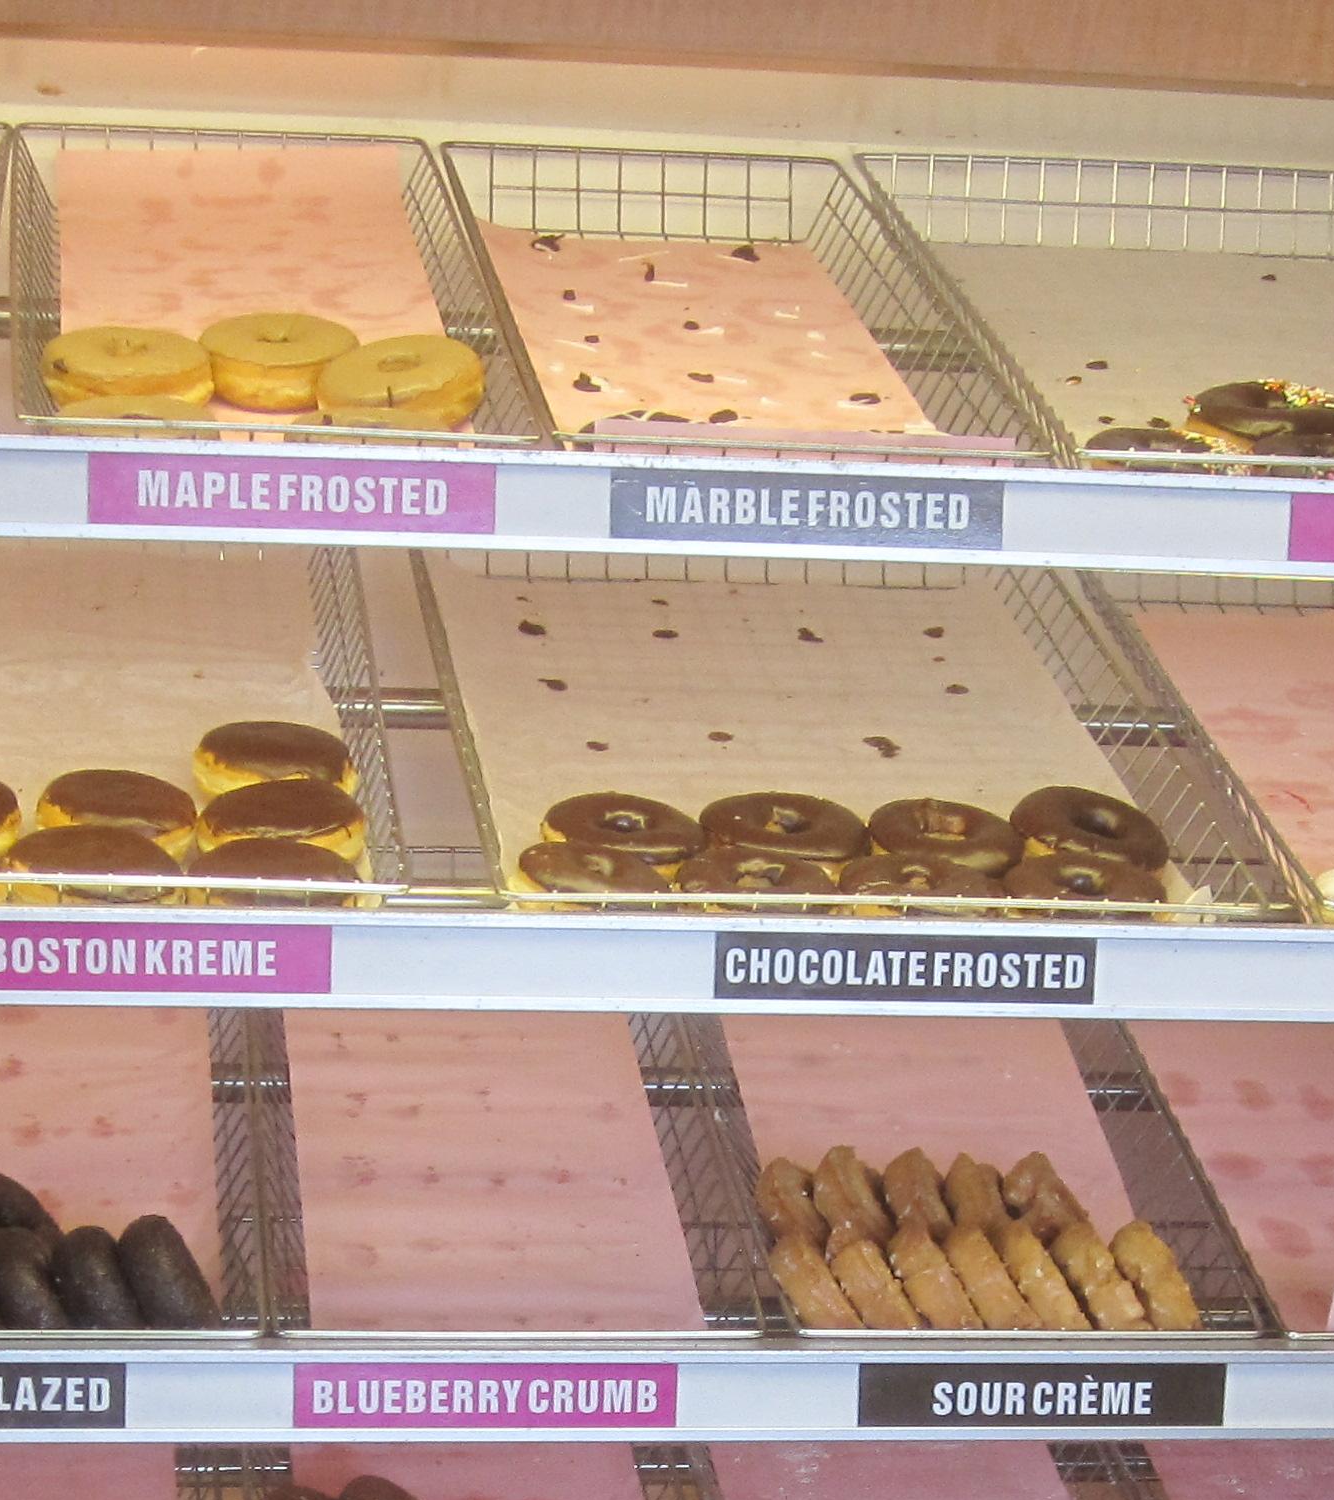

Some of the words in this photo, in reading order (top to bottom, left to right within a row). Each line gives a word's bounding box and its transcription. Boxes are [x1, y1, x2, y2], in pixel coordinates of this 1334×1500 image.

[137, 469, 271, 511] MAPLE
[278, 474, 448, 516] FROSTED
[645, 480, 800, 526] MARBLE
[807, 490, 970, 530] FROSTED
[145, 939, 277, 977] KREME
[725, 947, 927, 986] CHOCOLATE
[932, 951, 1086, 989] FROSTED
[312, 1379, 523, 1414] BLUEBERRY
[528, 1379, 658, 1414] CRUMB
[932, 1381, 1026, 1416] SOUR
[1032, 1374, 1153, 1416] CRÈME
